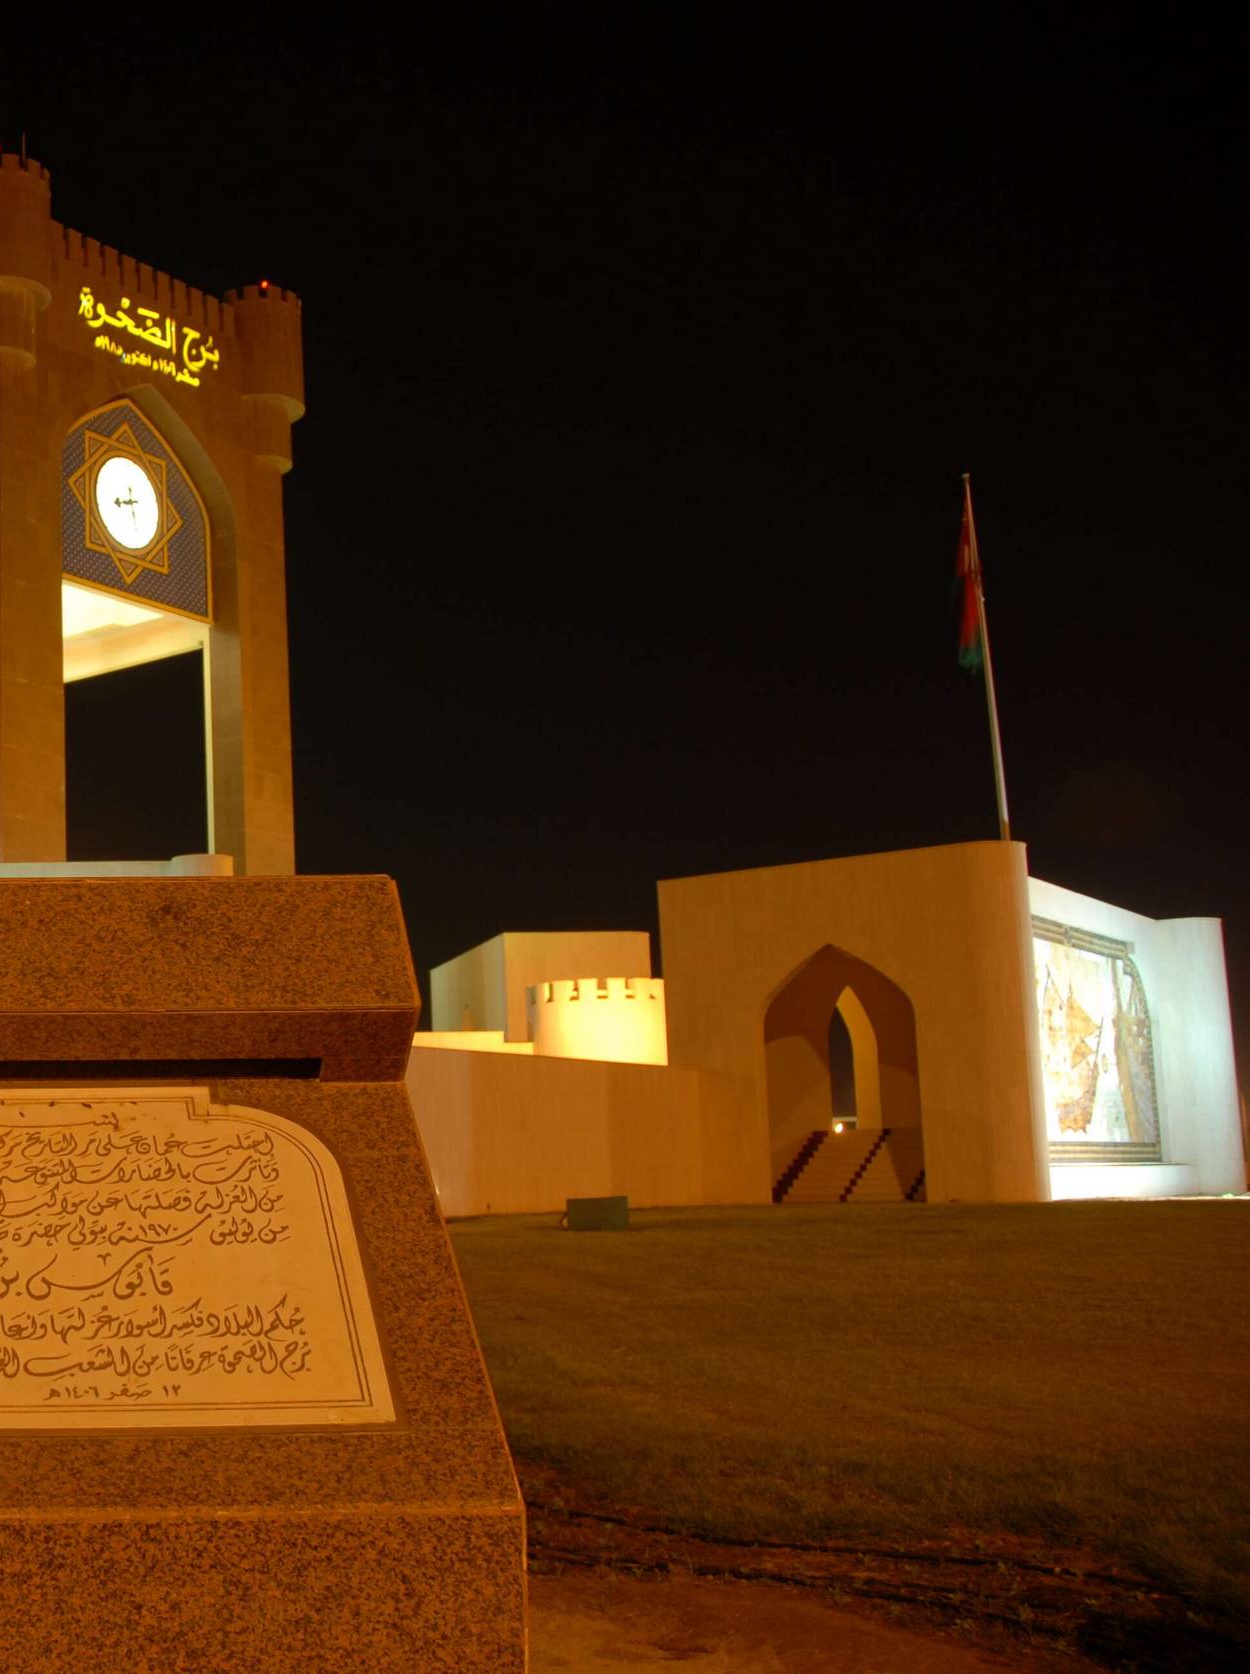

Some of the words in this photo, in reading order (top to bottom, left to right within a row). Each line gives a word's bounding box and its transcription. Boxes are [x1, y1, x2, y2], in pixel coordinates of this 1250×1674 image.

[182, 327, 220, 372] برج
[87, 1190, 123, 1215] عن
[258, 1186, 284, 1213] من
[140, 1223, 179, 1239] ١٩٧٠
[259, 1218, 291, 1245] من
[280, 1339, 311, 1381] برج
[104, 1383, 152, 1401] صفر
